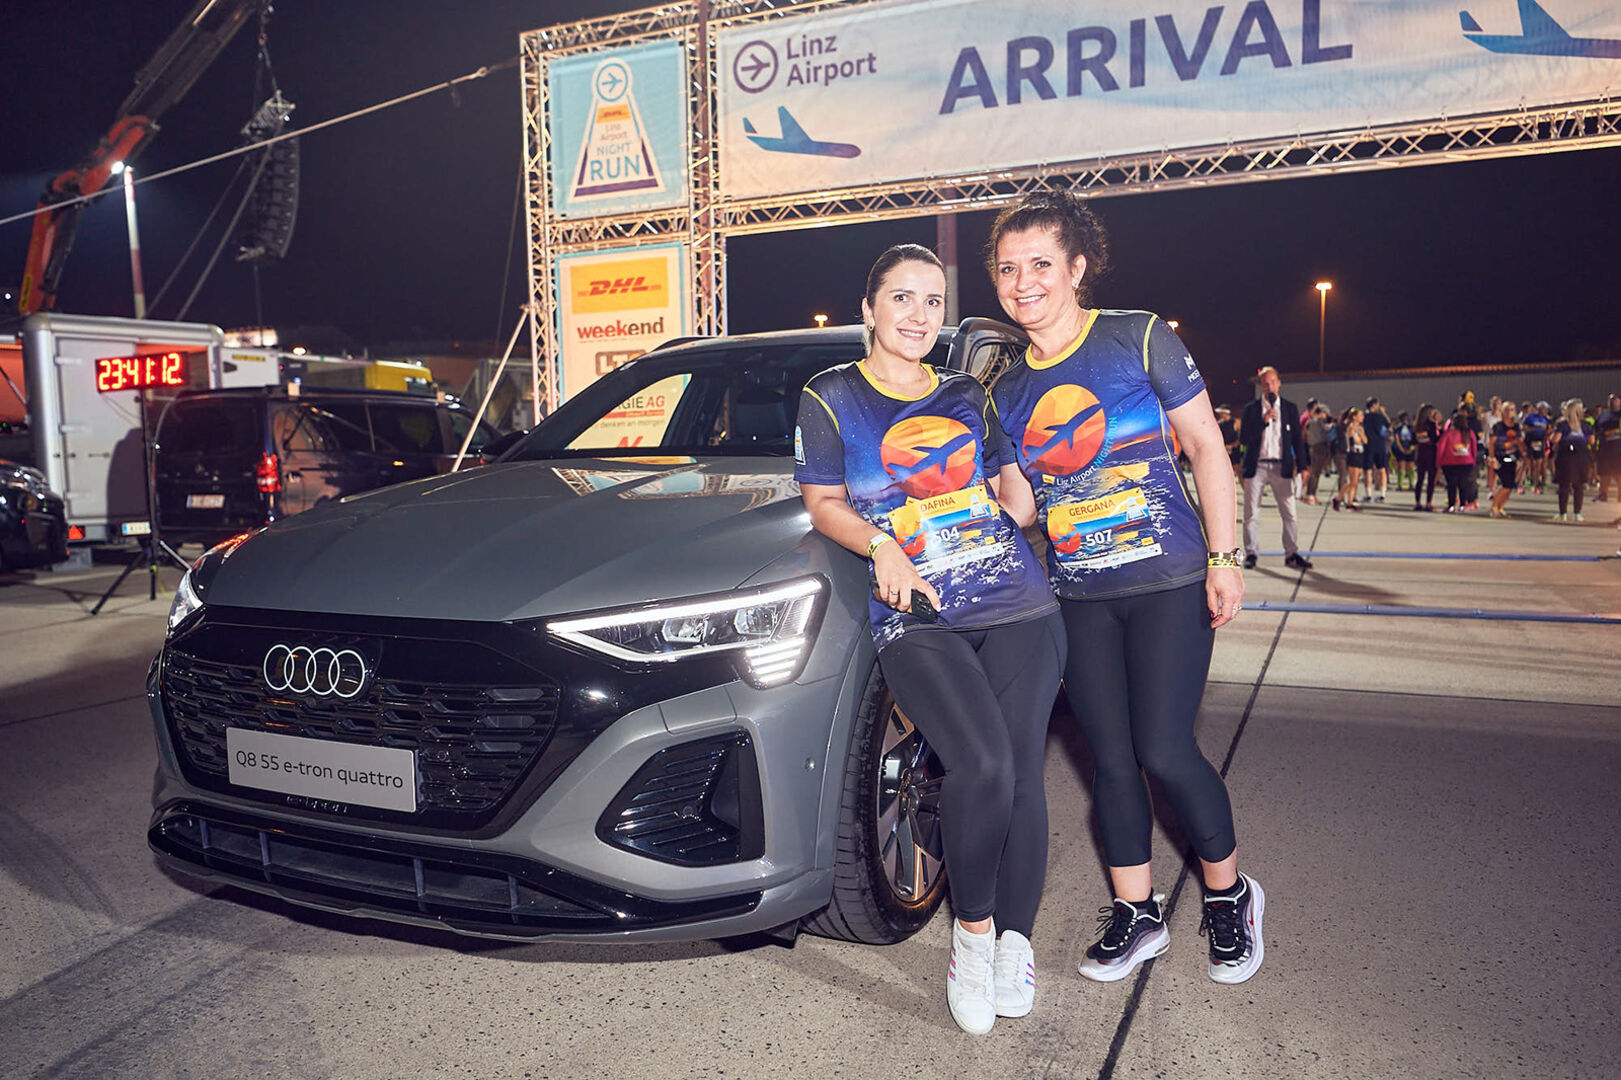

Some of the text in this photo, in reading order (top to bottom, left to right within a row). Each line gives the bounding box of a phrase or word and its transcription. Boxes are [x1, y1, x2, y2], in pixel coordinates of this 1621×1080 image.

[786, 34, 837, 60] Linz
[938, 0, 1353, 115] ARRIVAL
[786, 52, 877, 87] Airport
[596, 142, 631, 156] NIGHT
[590, 154, 640, 181] RUN
[589, 276, 649, 296] DHL
[577, 316, 664, 339] weekend
[645, 395, 665, 408] AG
[1070, 465, 1097, 485] Airport
[1093, 438, 1114, 470] NIGHT
[920, 496, 956, 513] DAFINA
[1069, 499, 1116, 517] GERGANA
[1085, 528, 1114, 547] 507
[235, 750, 404, 789] Q8 55 e-tron quattro
